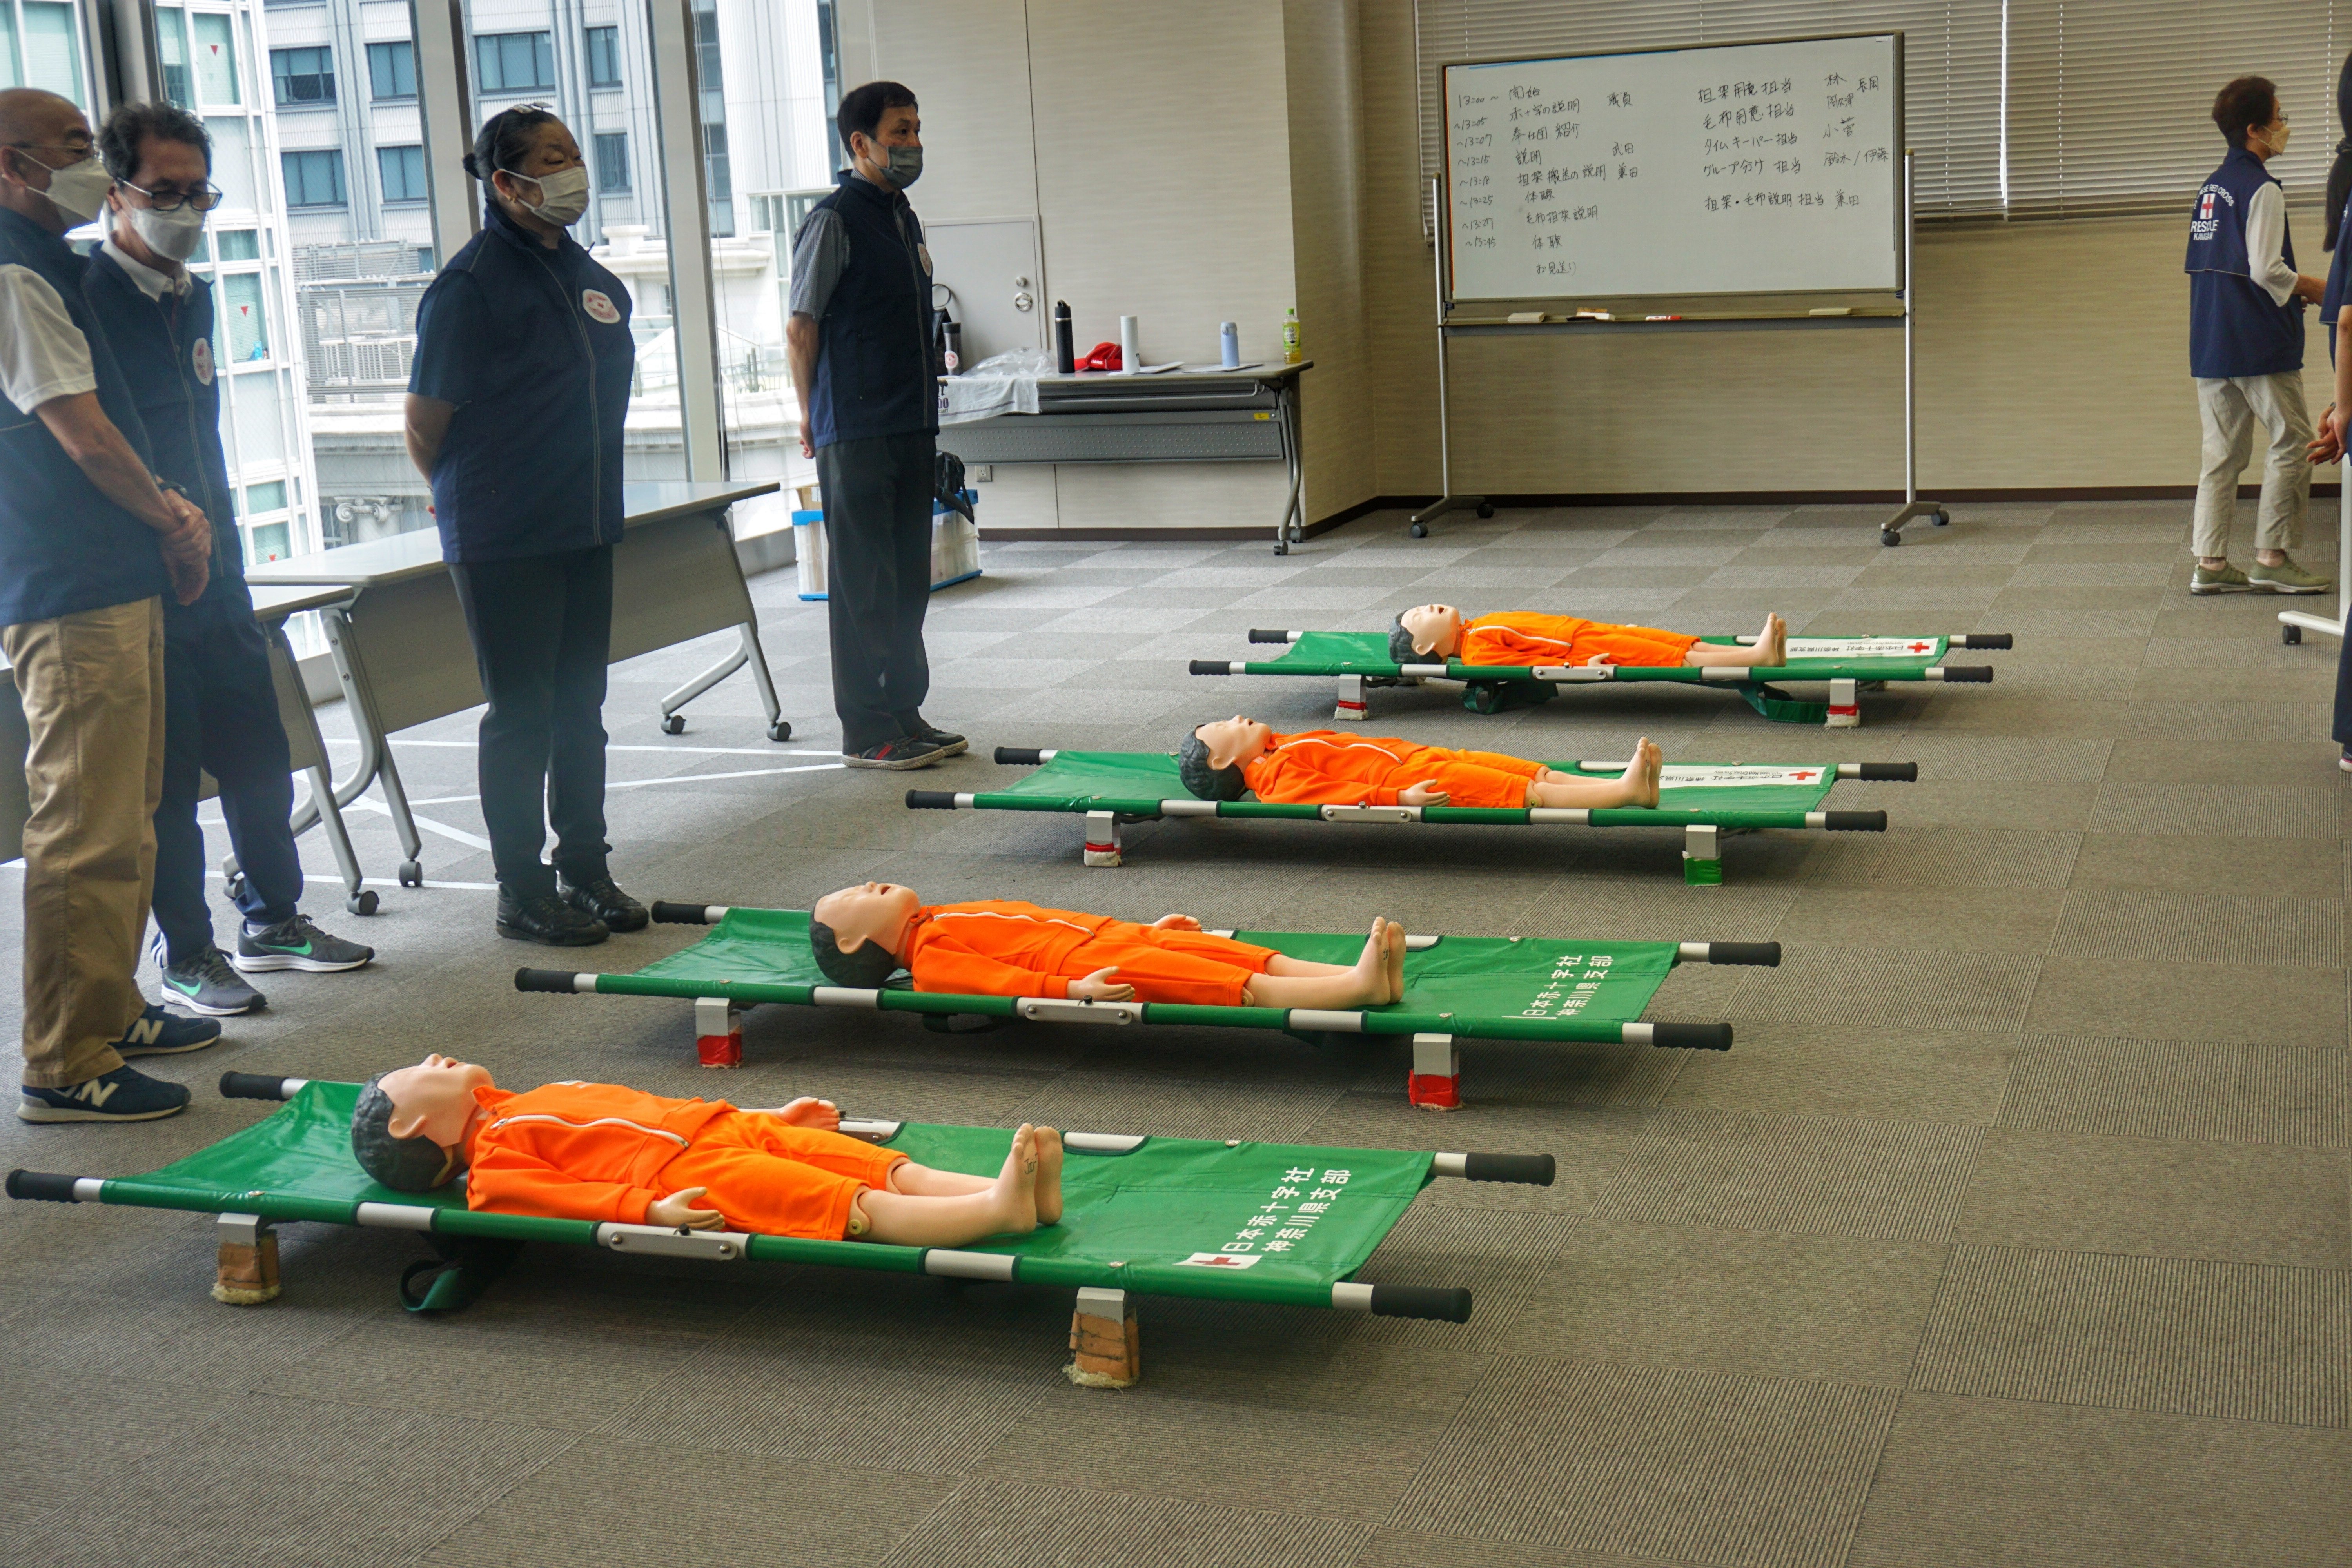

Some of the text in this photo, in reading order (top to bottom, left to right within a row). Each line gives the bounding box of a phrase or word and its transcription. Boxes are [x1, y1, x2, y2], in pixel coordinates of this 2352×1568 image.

[1509, 85, 1540, 100] 開始
[1824, 72, 1847, 86] 林
[1857, 75, 1879, 93] 長岡
[1509, 97, 1579, 122] 赤十字の説明
[1607, 91, 1633, 108] 職員
[1827, 93, 1854, 109] 阿久津
[1515, 148, 1541, 165] 説明
[1612, 142, 1634, 156] 武田
[1618, 162, 1638, 180] 兼田
[1532, 234, 1562, 250] 体験
[1536, 261, 1576, 275] お見送り
[1522, 955, 1583, 1016] 日本赤十字社
[1555, 955, 1614, 1016] 神奈川県支部
[1221, 1167, 1314, 1252] 日本赤十字社
[1261, 1169, 1351, 1252] 神奈川県支部
